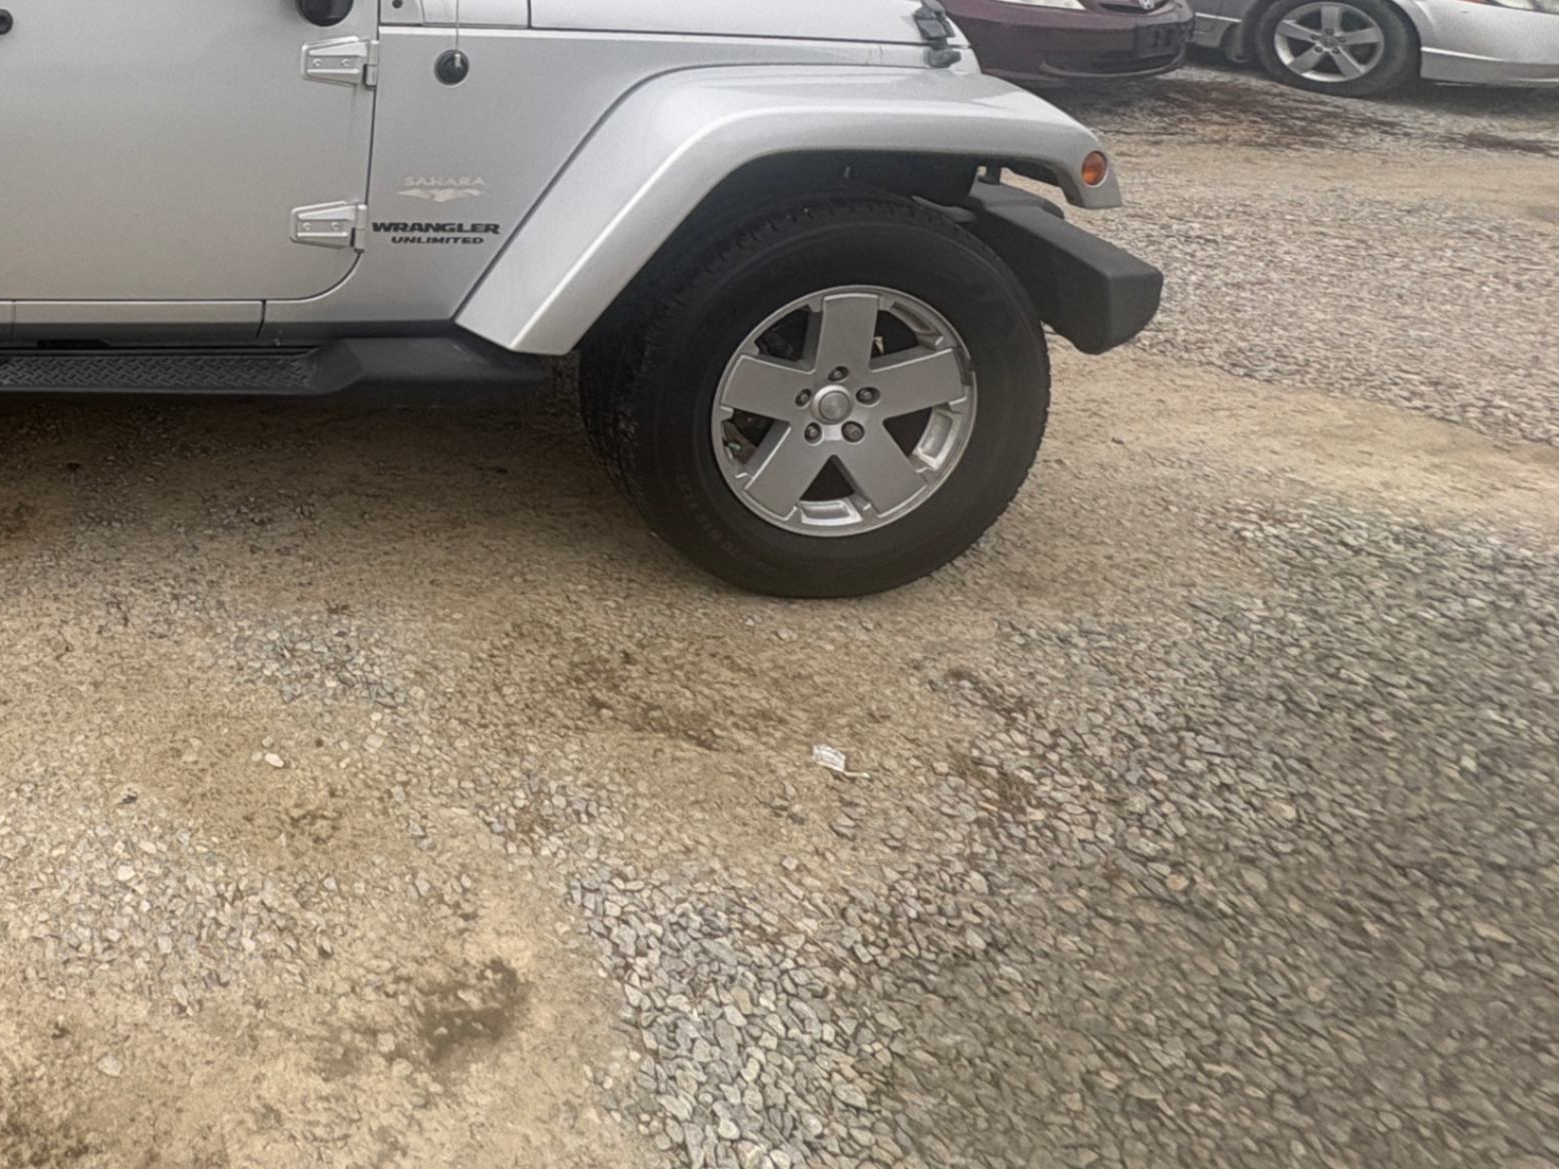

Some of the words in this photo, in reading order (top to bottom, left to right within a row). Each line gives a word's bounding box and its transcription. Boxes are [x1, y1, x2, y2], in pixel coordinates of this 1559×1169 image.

[403, 175, 486, 186] SAHARA
[372, 222, 501, 234] WRANGLER
[391, 236, 484, 245] UNLIMITED
